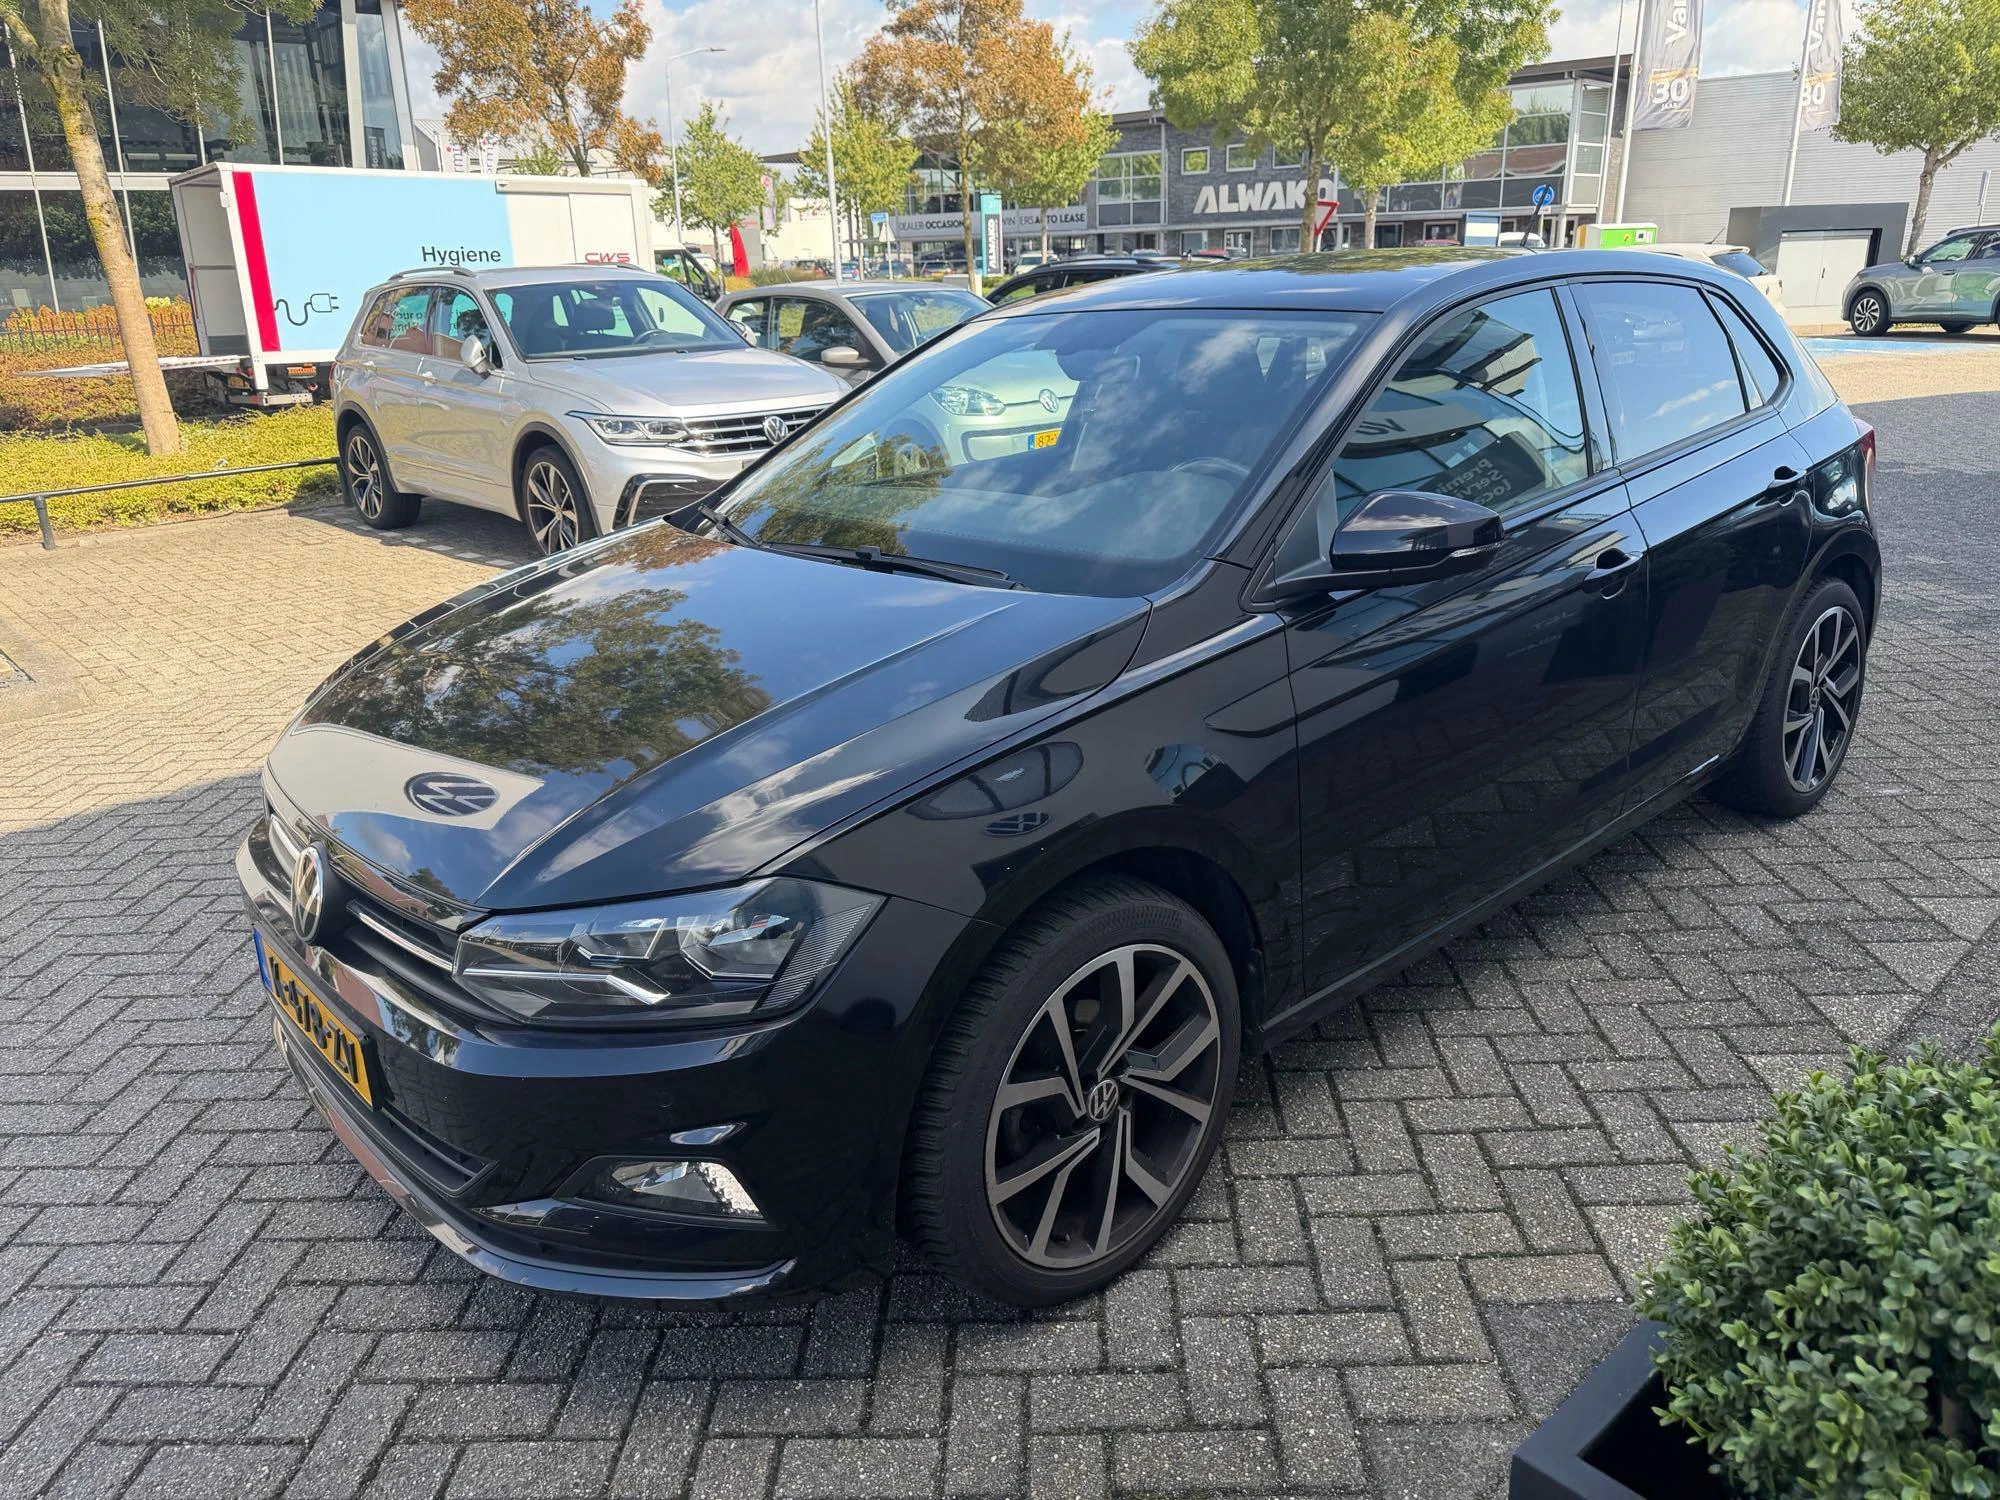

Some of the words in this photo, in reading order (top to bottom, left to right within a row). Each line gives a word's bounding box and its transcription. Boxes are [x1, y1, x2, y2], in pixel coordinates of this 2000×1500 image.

[1652, 78, 1688, 104] 30
[1193, 179, 1334, 214] ALWAKO
[1060, 213, 1085, 224] LEASE
[422, 246, 501, 266] Hygiene
[584, 252, 631, 264] CWS
